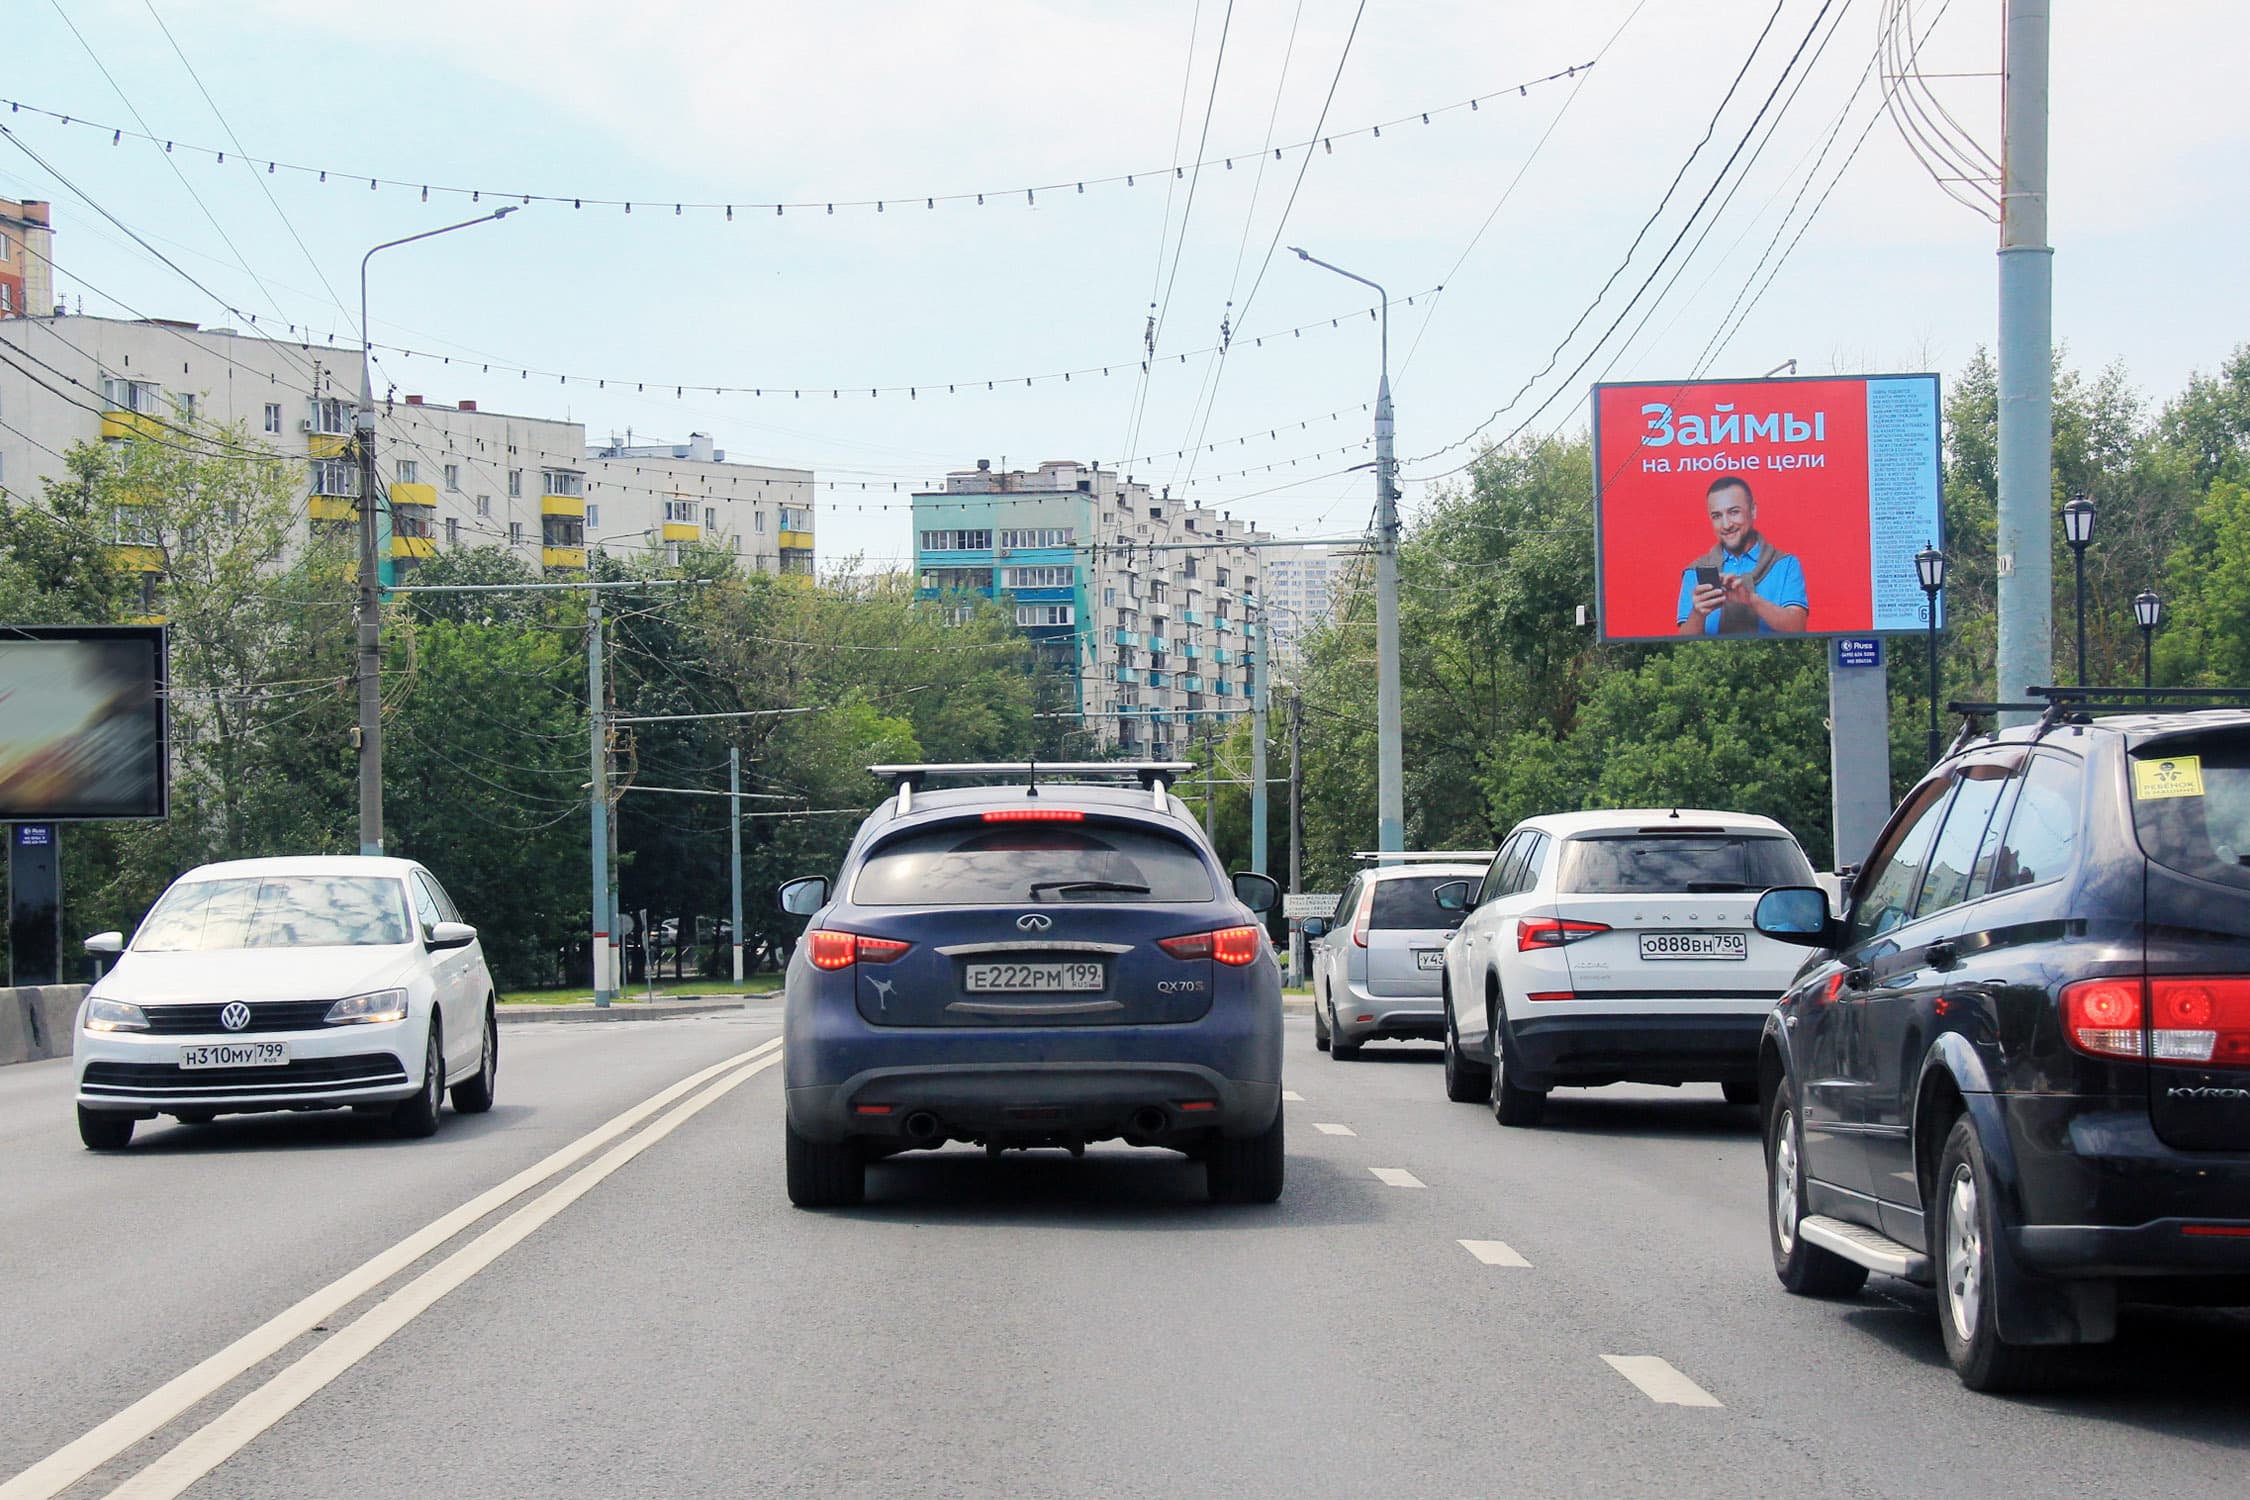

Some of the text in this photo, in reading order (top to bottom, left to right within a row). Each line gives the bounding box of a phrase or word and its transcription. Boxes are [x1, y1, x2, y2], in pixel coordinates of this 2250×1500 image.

[1641, 402, 1825, 447] Займы
[1642, 452, 1825, 473] на любые цели
[1646, 935, 1741, 952] О888ВН 750
[974, 965, 1098, 987] Е222РМ 199
[1157, 980, 1205, 995] QX70S
[222, 1002, 250, 1030] VW
[186, 1043, 283, 1065] Н310МУ 799
[2166, 1086, 2250, 1097] KYRON
